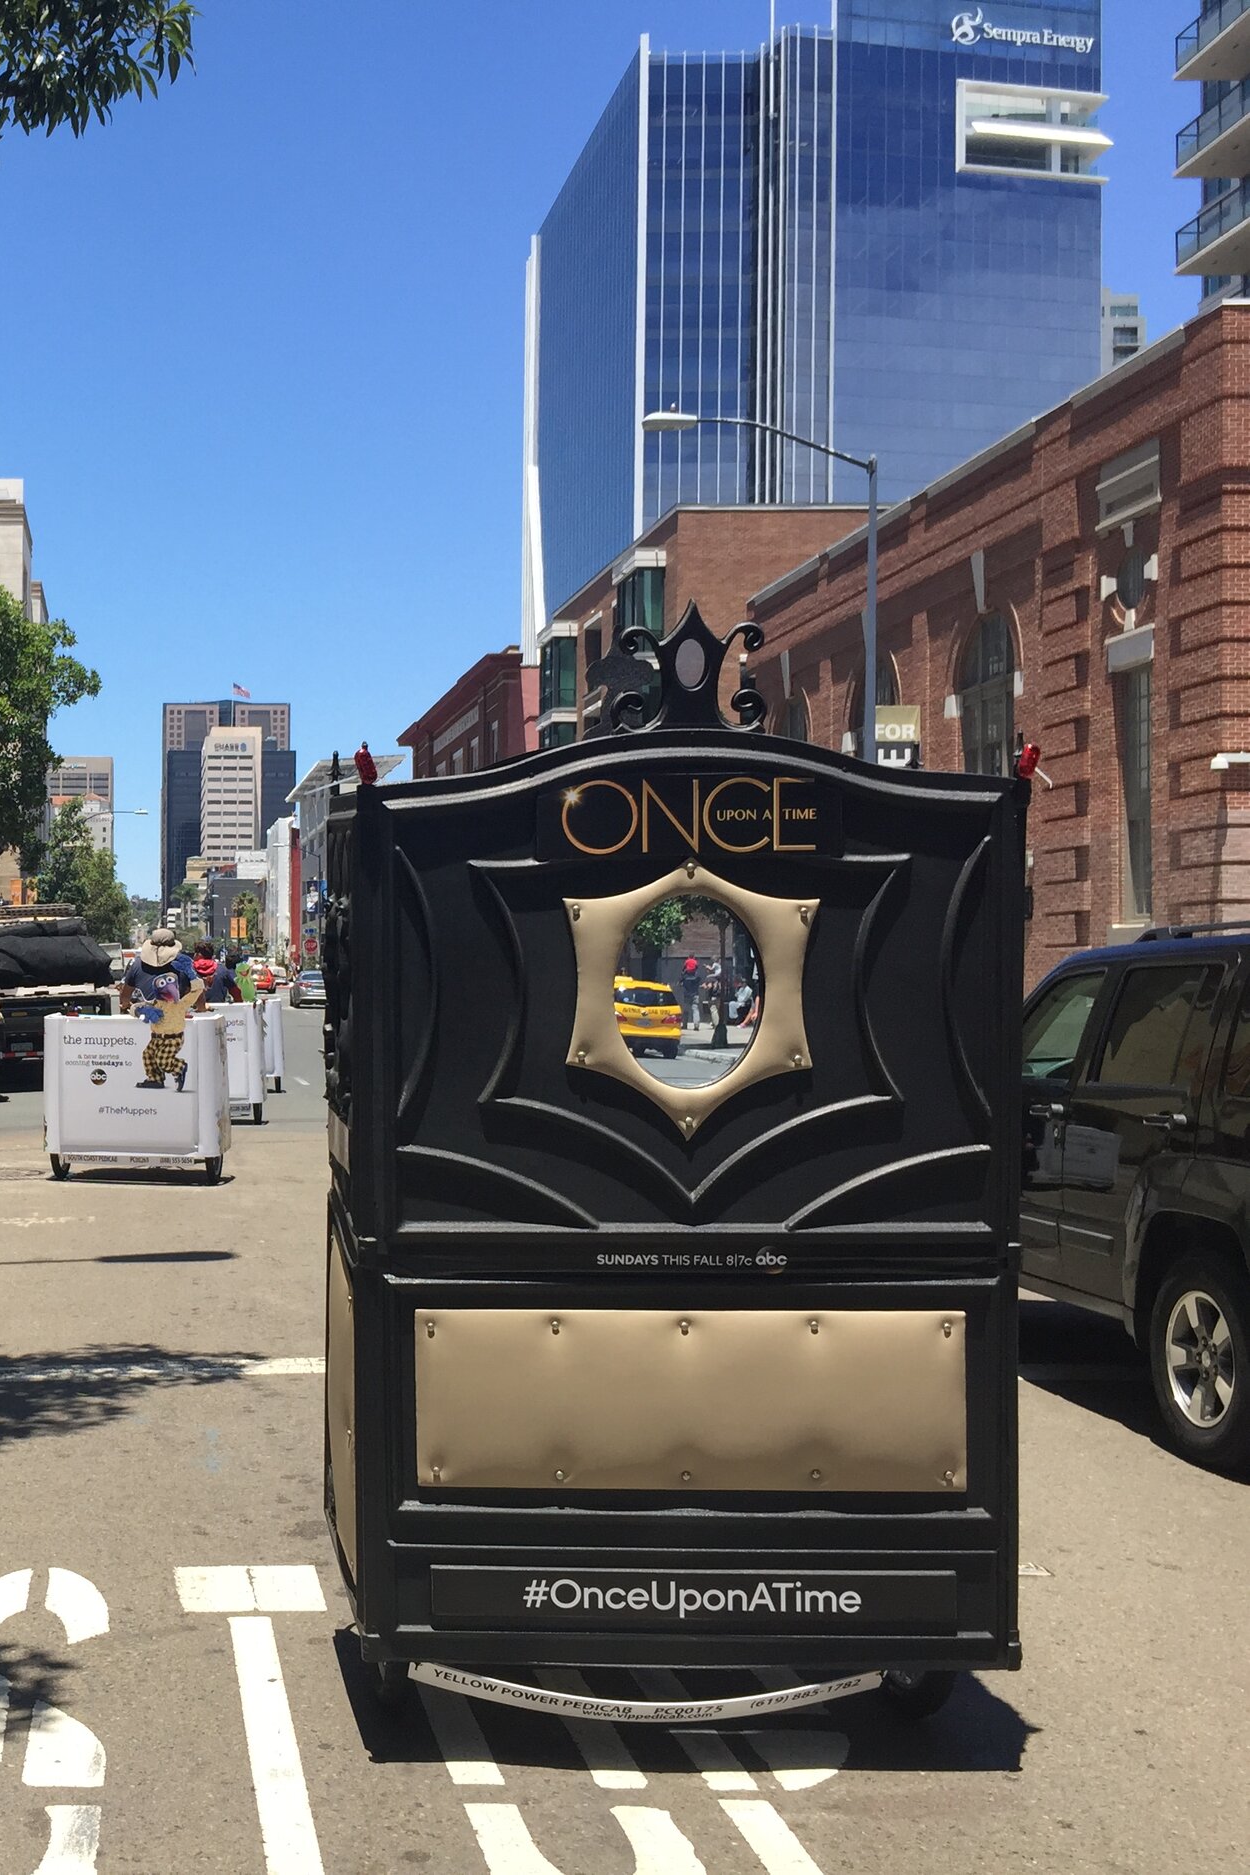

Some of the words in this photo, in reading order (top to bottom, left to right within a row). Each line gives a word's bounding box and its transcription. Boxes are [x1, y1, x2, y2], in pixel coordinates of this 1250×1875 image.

[983, 22, 1040, 46] Sempra
[1043, 29, 1094, 53] Energy
[875, 724, 915, 740] FOR
[561, 777, 816, 855] ONCE
[717, 809, 757, 821] UPON
[762, 810, 772, 820] A
[782, 808, 817, 820] TIME
[63, 1035, 82, 1045] the
[84, 1036, 137, 1047] muppets.
[90, 1072, 106, 1080] abc
[98, 1106, 157, 1115] #TheMuppets
[596, 1254, 659, 1265] SUNDAYS
[662, 1255, 691, 1265] THIS
[694, 1255, 723, 1266] FALL
[755, 1252, 788, 1266] abc
[523, 1578, 862, 1619] #OnceUponATime
[434, 1669, 497, 1692] YELLOW
[501, 1687, 558, 1706] POWER
[563, 1700, 632, 1713] PEDICAB
[654, 1705, 724, 1715] PC00175
[750, 1695, 789, 1709] (619)
[792, 1679, 861, 1701] 885-1782
[583, 1710, 712, 1720] www.vippedicab.com
